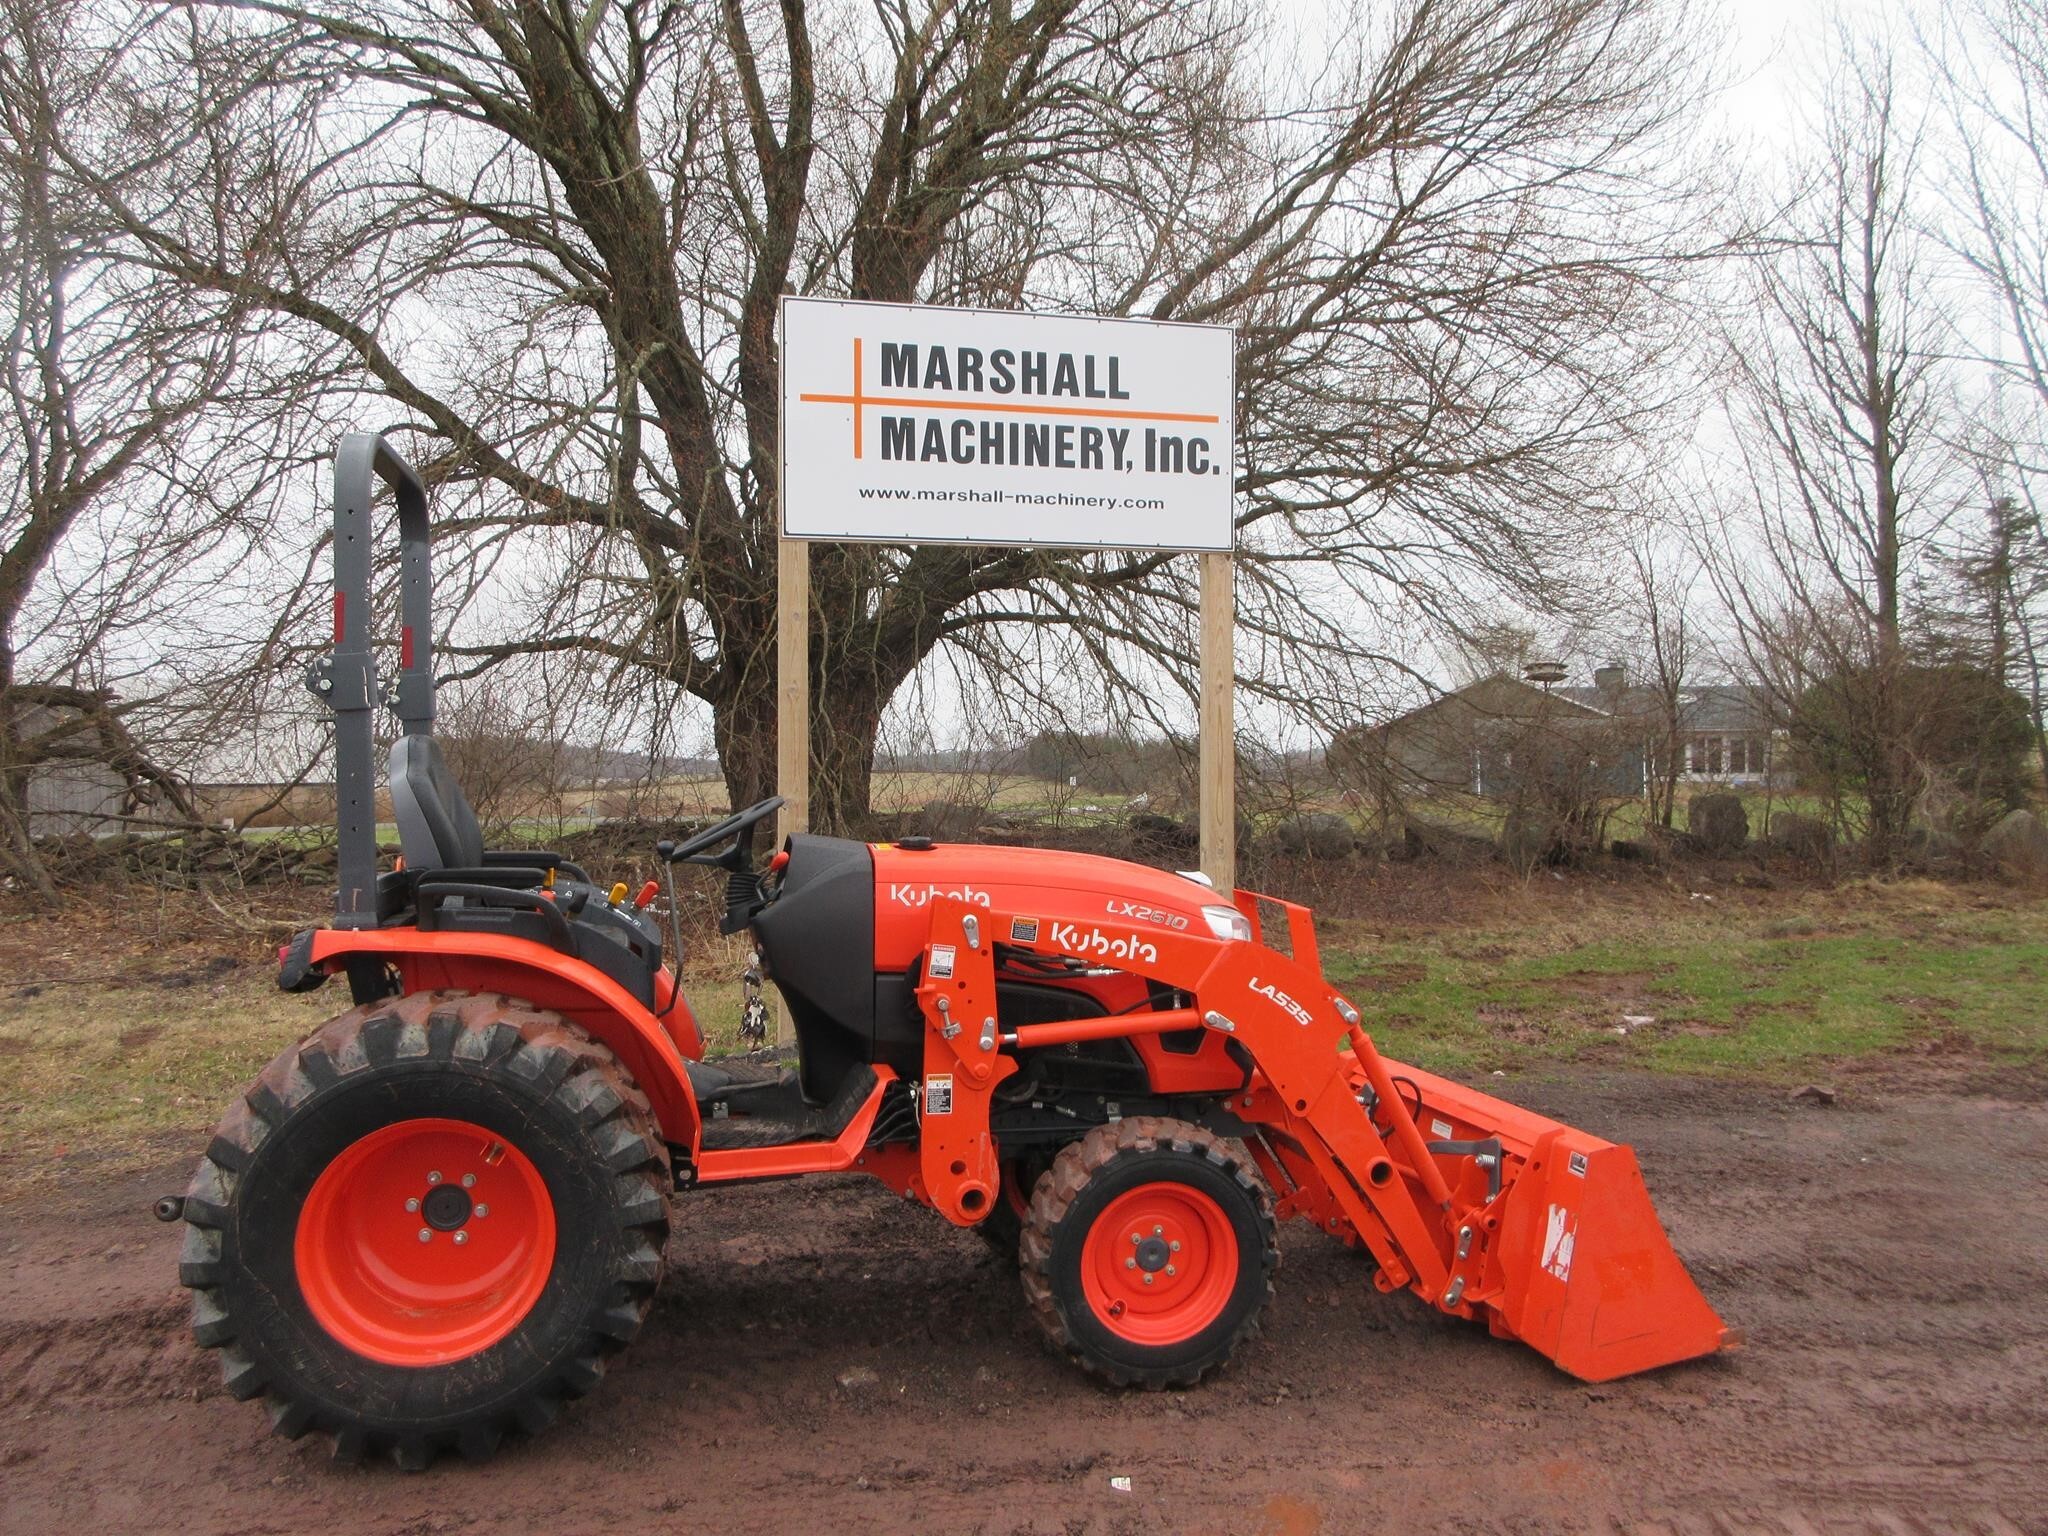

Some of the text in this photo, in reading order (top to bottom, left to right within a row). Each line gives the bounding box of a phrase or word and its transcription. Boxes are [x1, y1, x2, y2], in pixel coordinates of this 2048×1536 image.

[881, 343, 1129, 399] MARSHALL
[880, 416, 1220, 475] MACHINERY, Inc.
[858, 486, 1165, 510] www.marshall-machinery.com
[1106, 900, 1188, 930] LX2610
[1050, 921, 1158, 963] Kubota
[1248, 976, 1313, 1026] LA535
